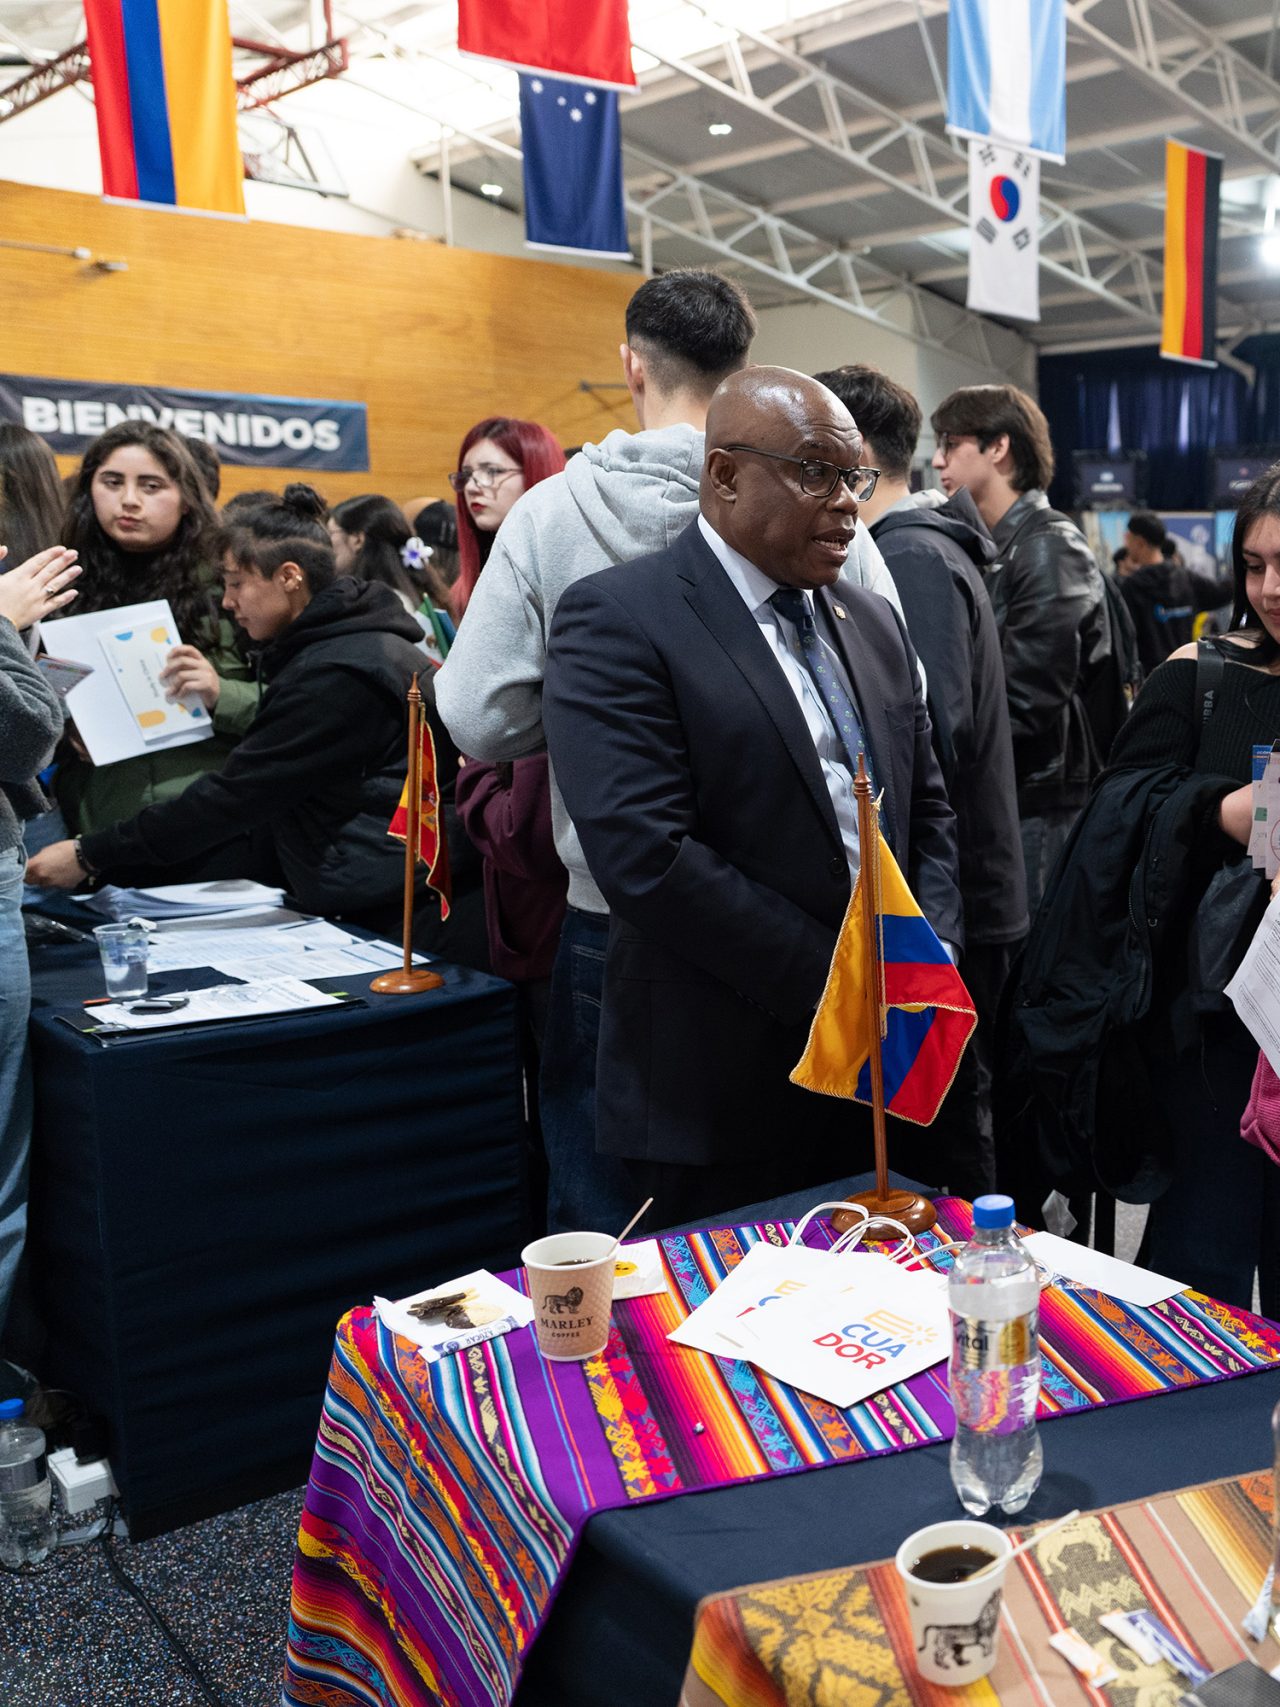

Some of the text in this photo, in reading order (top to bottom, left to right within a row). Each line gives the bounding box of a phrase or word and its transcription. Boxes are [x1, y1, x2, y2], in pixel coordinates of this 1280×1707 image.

[22, 396, 340, 451] BIENVENIDOS
[541, 1316, 594, 1330] MARLEY
[841, 1323, 907, 1358] CUA
[812, 1332, 886, 1370] DOR
